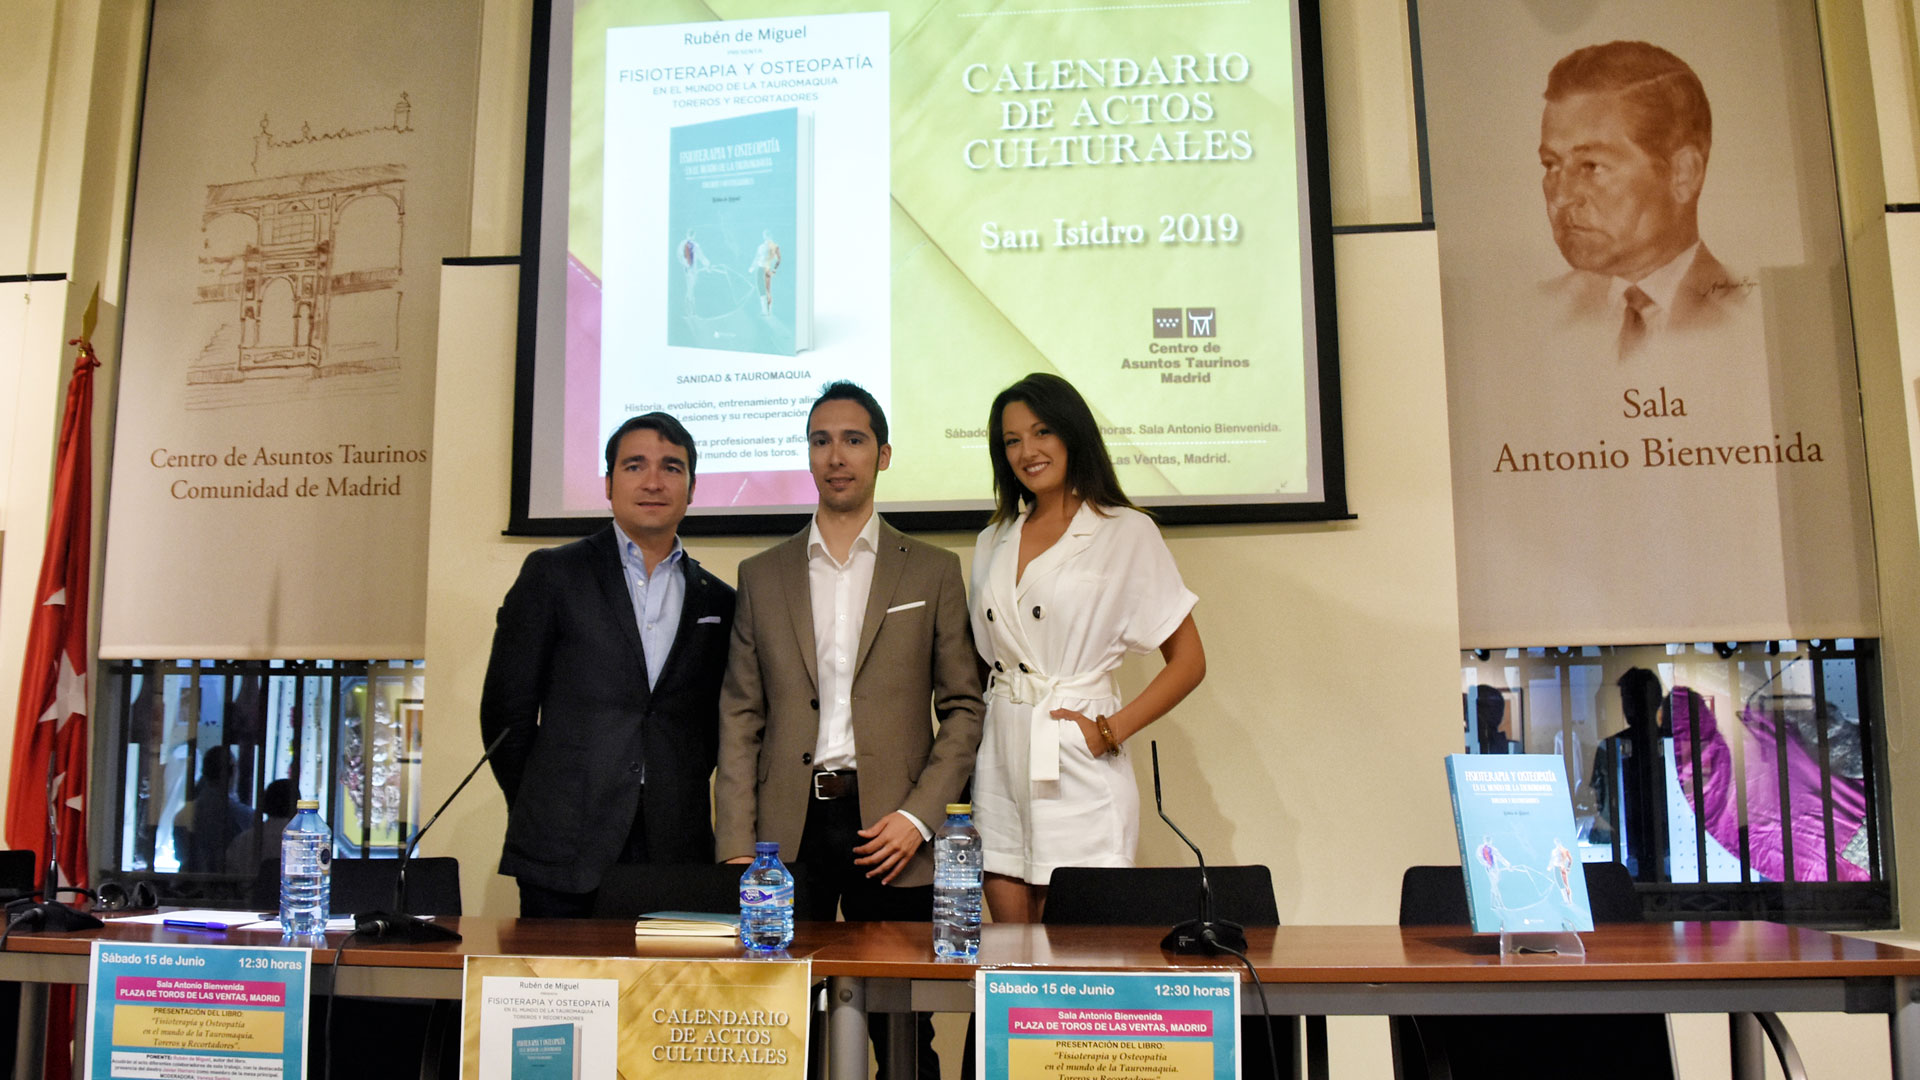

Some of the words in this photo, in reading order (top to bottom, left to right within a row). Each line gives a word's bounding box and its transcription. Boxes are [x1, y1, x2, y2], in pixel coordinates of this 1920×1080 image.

[684, 30, 730, 45] Rubén
[735, 29, 753, 42] de
[758, 25, 806, 43] Miguel
[619, 64, 737, 82] FISIOTERAPIA
[744, 63, 754, 75] Y
[760, 54, 873, 75] OSTEOPATÍA
[962, 52, 1251, 94] CALENDARIO
[653, 87, 667, 95] EN
[670, 86, 681, 95] EL
[684, 83, 723, 93] MUNDO
[727, 82, 741, 91] DE
[743, 81, 757, 90] LA
[760, 76, 838, 89] TAUROMAQUIA
[673, 98, 720, 108] TOREROS
[724, 97, 731, 105] Y
[733, 92, 818, 105] RECORTADORES
[1000, 98, 1054, 131] DE
[1072, 91, 1215, 127] ACTOS
[962, 130, 1254, 170] CULTURALES
[981, 221, 1039, 251] San
[1054, 216, 1144, 247] Isidro
[1159, 213, 1241, 244] 2019
[1149, 342, 1198, 354] Centro
[1203, 342, 1221, 353] de
[1121, 358, 1181, 369] Asuntos
[1185, 357, 1250, 368] Taurinos
[677, 374, 722, 384] SANIDAD
[725, 373, 732, 382] &
[735, 370, 811, 382] TAUROMAQUIA
[1161, 372, 1211, 383] Madrid
[624, 402, 665, 412] Historia,
[667, 399, 716, 411] evolución,
[719, 396, 788, 408] entrenamiento
[789, 397, 797, 407] y
[1622, 386, 1688, 419] Sala
[721, 413, 727, 423] y
[729, 412, 741, 421] su
[743, 409, 808, 421] recuperación
[1139, 424, 1164, 434] Sala
[1167, 423, 1211, 434] Antonio
[1214, 422, 1281, 434] Bienvenida.
[710, 436, 776, 449] profesionales
[778, 437, 784, 446] y
[150, 448, 217, 469] Centro
[223, 446, 247, 467] de
[253, 447, 333, 467] Asuntos
[338, 443, 428, 464] Taurinos
[705, 449, 737, 459] mundo
[740, 449, 752, 458] de
[754, 448, 768, 457] los
[771, 448, 799, 457] toros.
[1492, 440, 1630, 473] Antonio
[1641, 431, 1824, 468] Bienvenida
[1134, 454, 1180, 466] Ventas,
[1184, 453, 1231, 464] Madrid.
[170, 477, 288, 500] Comunidad
[295, 476, 319, 498] de
[326, 475, 402, 498] Madrid
[101, 952, 142, 964] Sábado
[144, 954, 158, 965] 15
[159, 955, 173, 965] de
[175, 956, 205, 966] Junio
[239, 957, 268, 968] 12:30
[270, 959, 302, 970] horas
[156, 980, 172, 988] Sala
[174, 981, 202, 989] Antonio
[203, 982, 244, 991] Bienvenida
[520, 981, 542, 989] Rubén
[555, 982, 579, 991] Miguel
[989, 982, 1038, 994] Sábado
[1041, 983, 1057, 994] 15
[1060, 983, 1076, 995] de
[1079, 984, 1115, 996] Junio
[1154, 984, 1190, 996] 12:30
[1193, 985, 1230, 997] horas
[120, 989, 145, 997] PLAZA
[146, 989, 157, 998] DE
[158, 990, 185, 998] TOROS
[186, 991, 198, 999] DE
[199, 991, 214, 1000] LAS
[215, 993, 249, 1002] VENTAS,
[250, 994, 280, 1002] MADRID
[488, 996, 545, 1006] FISIOTERAPIA
[556, 998, 610, 1007] OSTEOPATÍA
[154, 1007, 205, 1016] PRESENTACIÓN
[207, 1009, 220, 1017] DEL
[652, 1008, 789, 1026] CALENDARIO
[1058, 1011, 1077, 1019] Sala
[1079, 1011, 1112, 1020] Antonio
[1114, 1012, 1163, 1021] Bienvenida
[1014, 1021, 1044, 1029] PLAZA
[1046, 1022, 1059, 1030] DE
[1060, 1022, 1092, 1031] TOROS
[1095, 1023, 1107, 1031] DE
[1109, 1023, 1127, 1031] LAS
[1128, 1023, 1169, 1033] VENTAS,
[1170, 1024, 1207, 1032] MADRID
[161, 1028, 184, 1036] mundo
[205, 1030, 254, 1040] Tauromaquia.
[670, 1027, 696, 1044] DE
[703, 1028, 771, 1045] ACTOS
[154, 1038, 180, 1047] Toreros
[1056, 1040, 1118, 1049] PRESENTACIÓN
[1121, 1041, 1135, 1049] DEL
[1137, 1042, 1165, 1050] LIBRO:
[652, 1046, 788, 1065] CULTURALES
[1112, 1054, 1117, 1062] y
[1119, 1052, 1167, 1064] Osteopatía
[1056, 1063, 1064, 1071] el
[1066, 1063, 1095, 1071] mundo
[1097, 1063, 1107, 1071] de
[1109, 1063, 1117, 1072] la
[1119, 1064, 1179, 1075] Tauromaquia.
